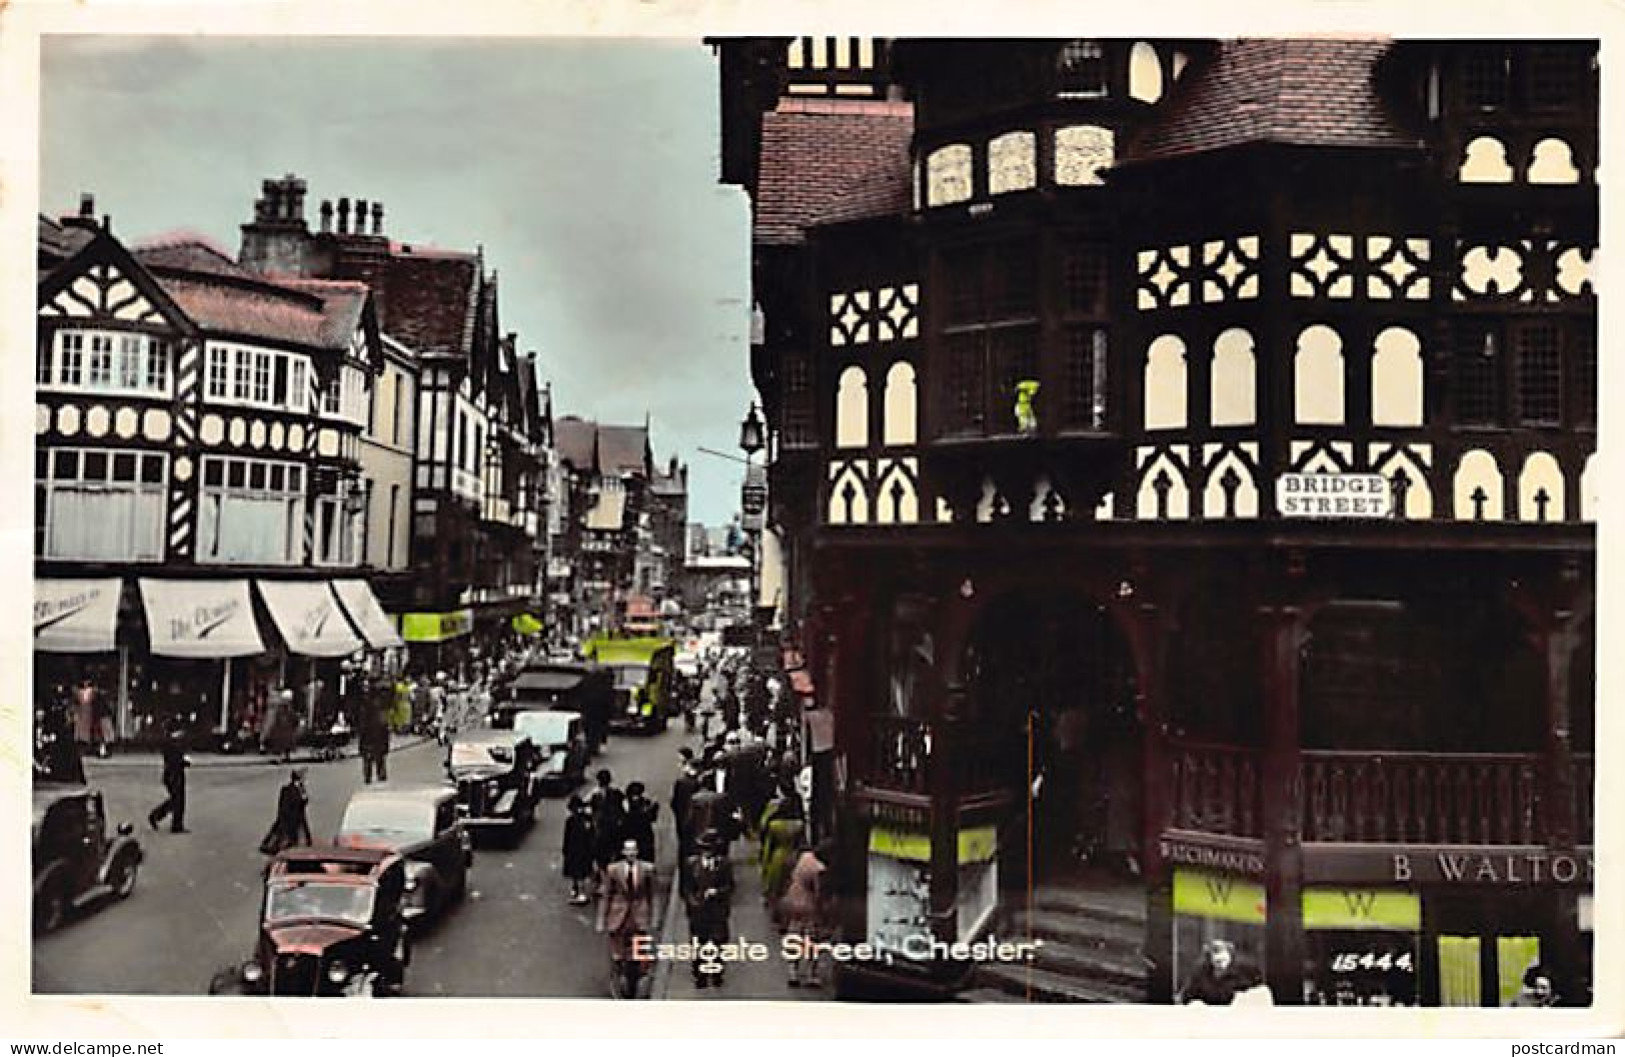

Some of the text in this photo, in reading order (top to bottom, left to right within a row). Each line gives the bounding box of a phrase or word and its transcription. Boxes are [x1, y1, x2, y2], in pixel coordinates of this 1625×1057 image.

[1285, 477, 1384, 493] BRIDGE
[1285, 497, 1384, 513] STREET
[1394, 854, 1412, 881] B
